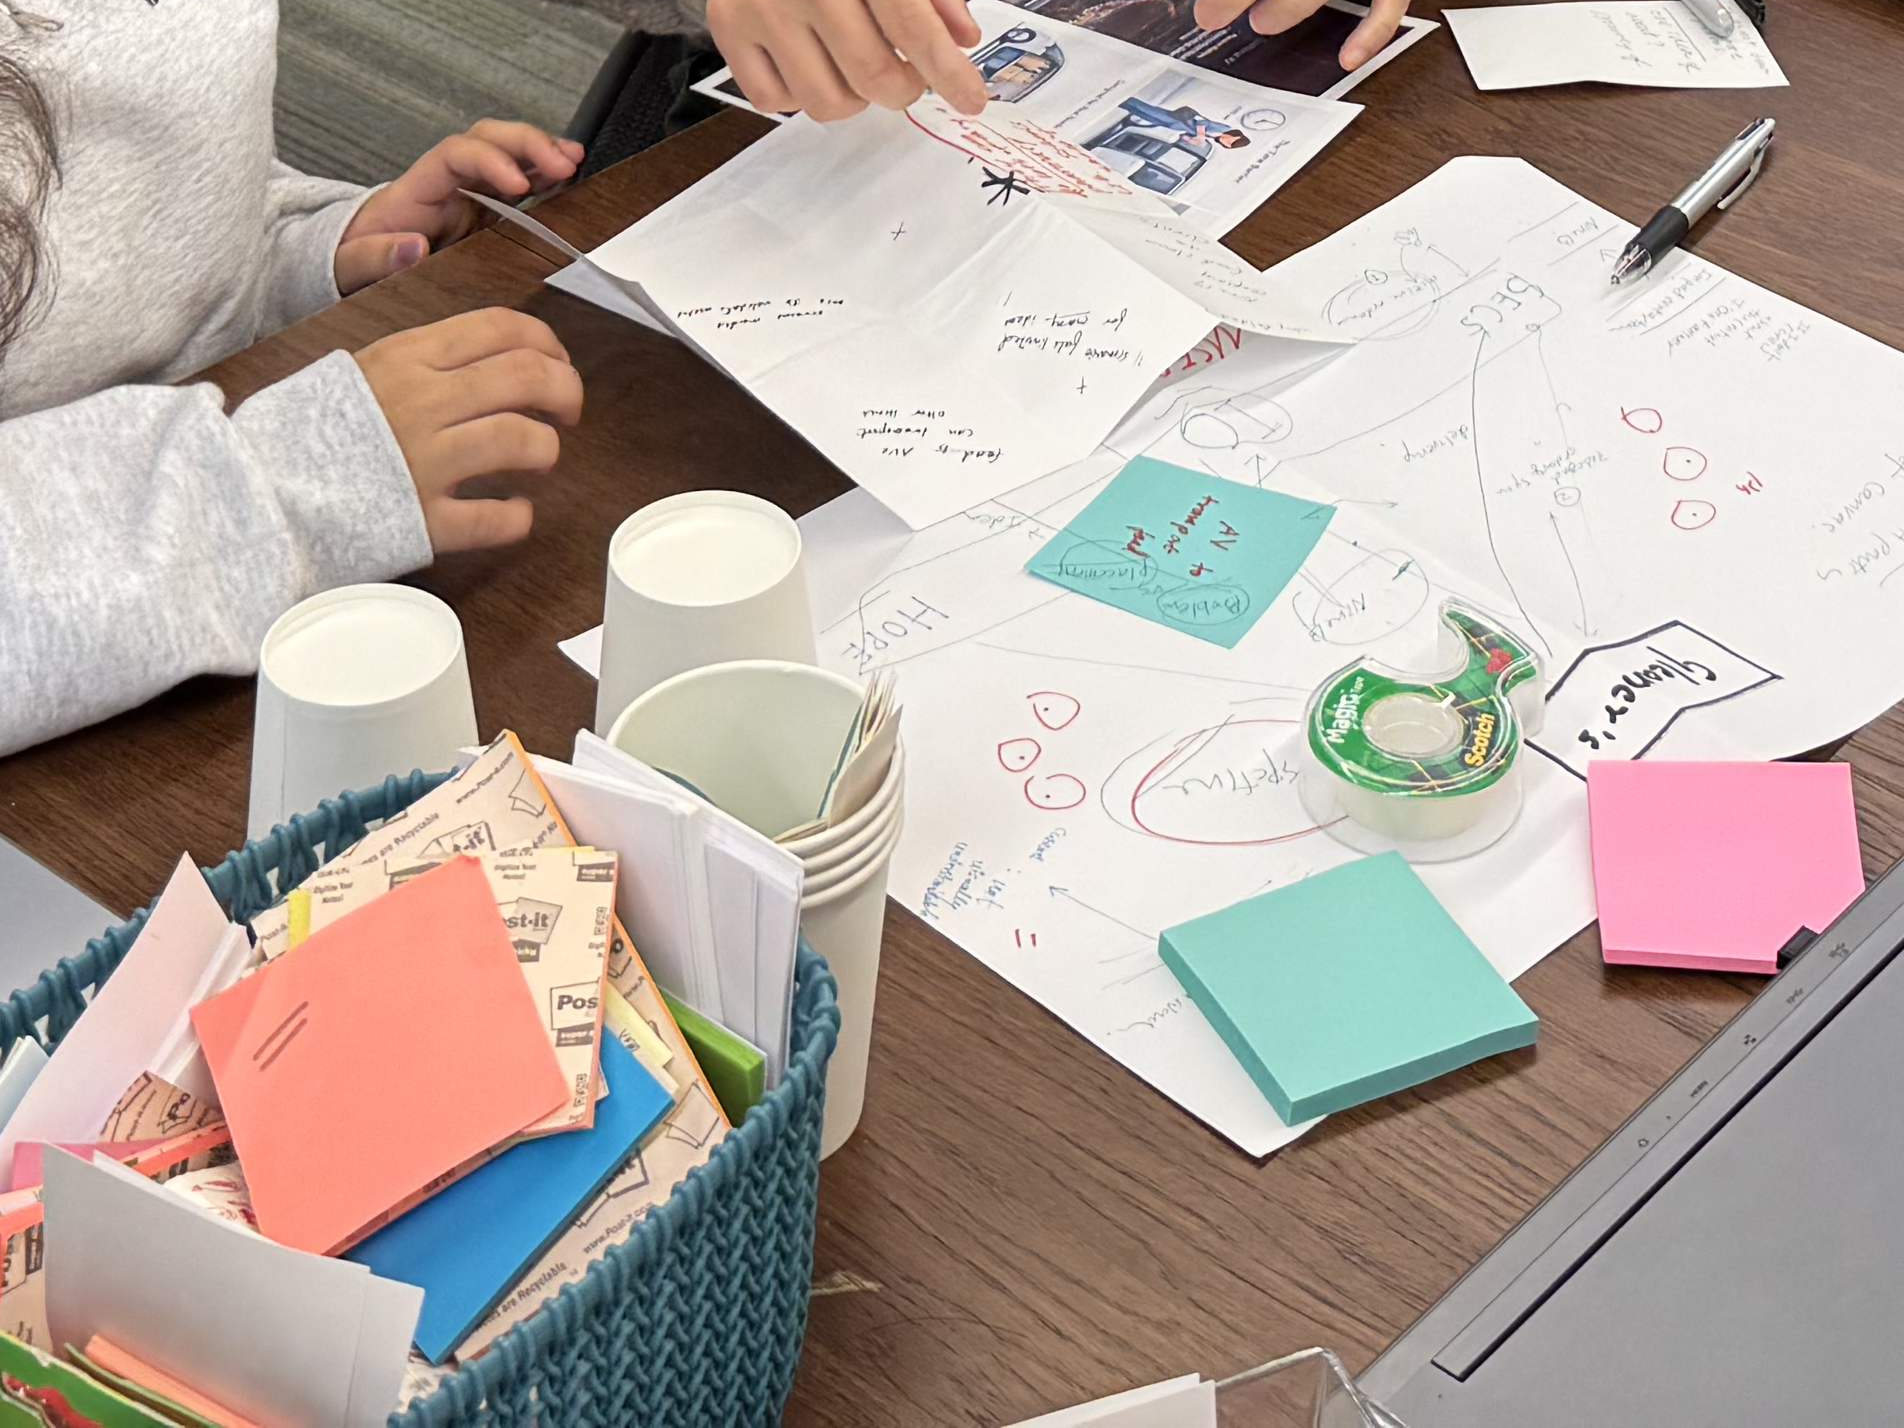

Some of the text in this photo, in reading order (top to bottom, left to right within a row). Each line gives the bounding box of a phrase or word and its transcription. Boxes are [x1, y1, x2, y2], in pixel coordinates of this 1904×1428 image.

[1326, 693, 1360, 743] Magic
[1464, 714, 1495, 766] Scotch
[518, 1262, 568, 1301] Recyclable
